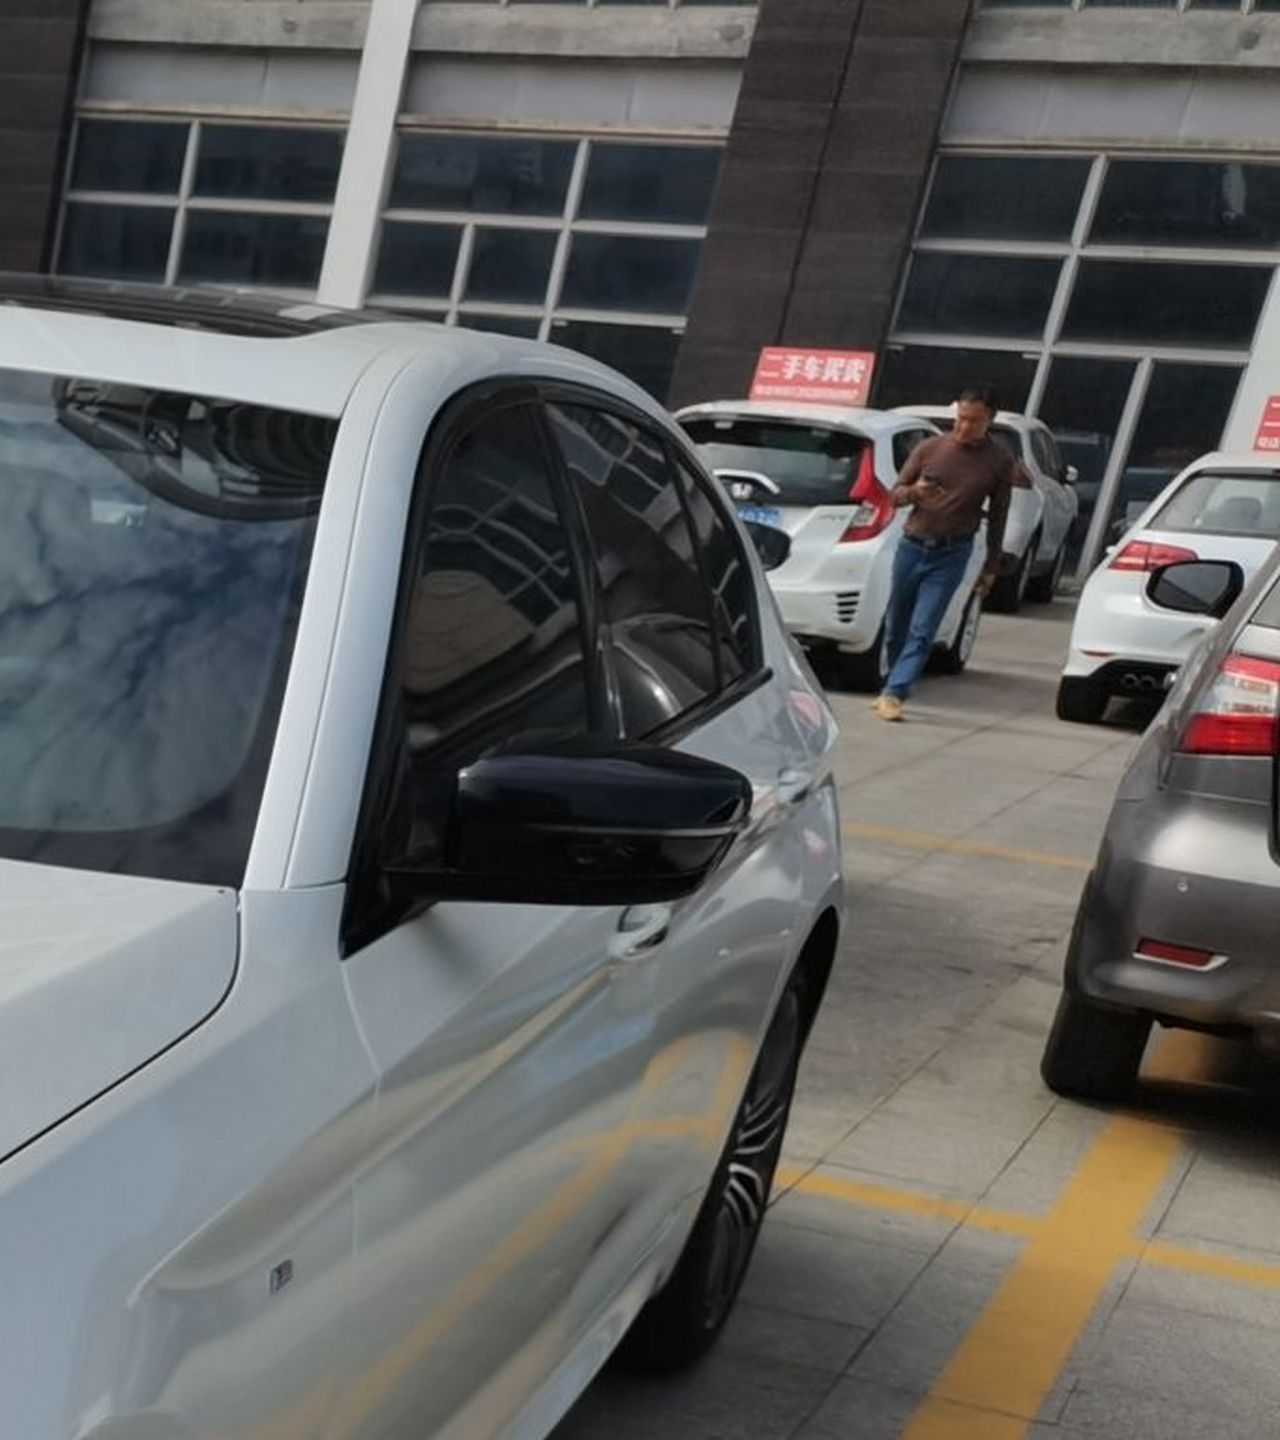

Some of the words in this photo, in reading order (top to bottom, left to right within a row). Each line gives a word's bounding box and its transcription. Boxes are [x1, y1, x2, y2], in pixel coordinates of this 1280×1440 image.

[759, 354, 866, 383] 二手车买卖
